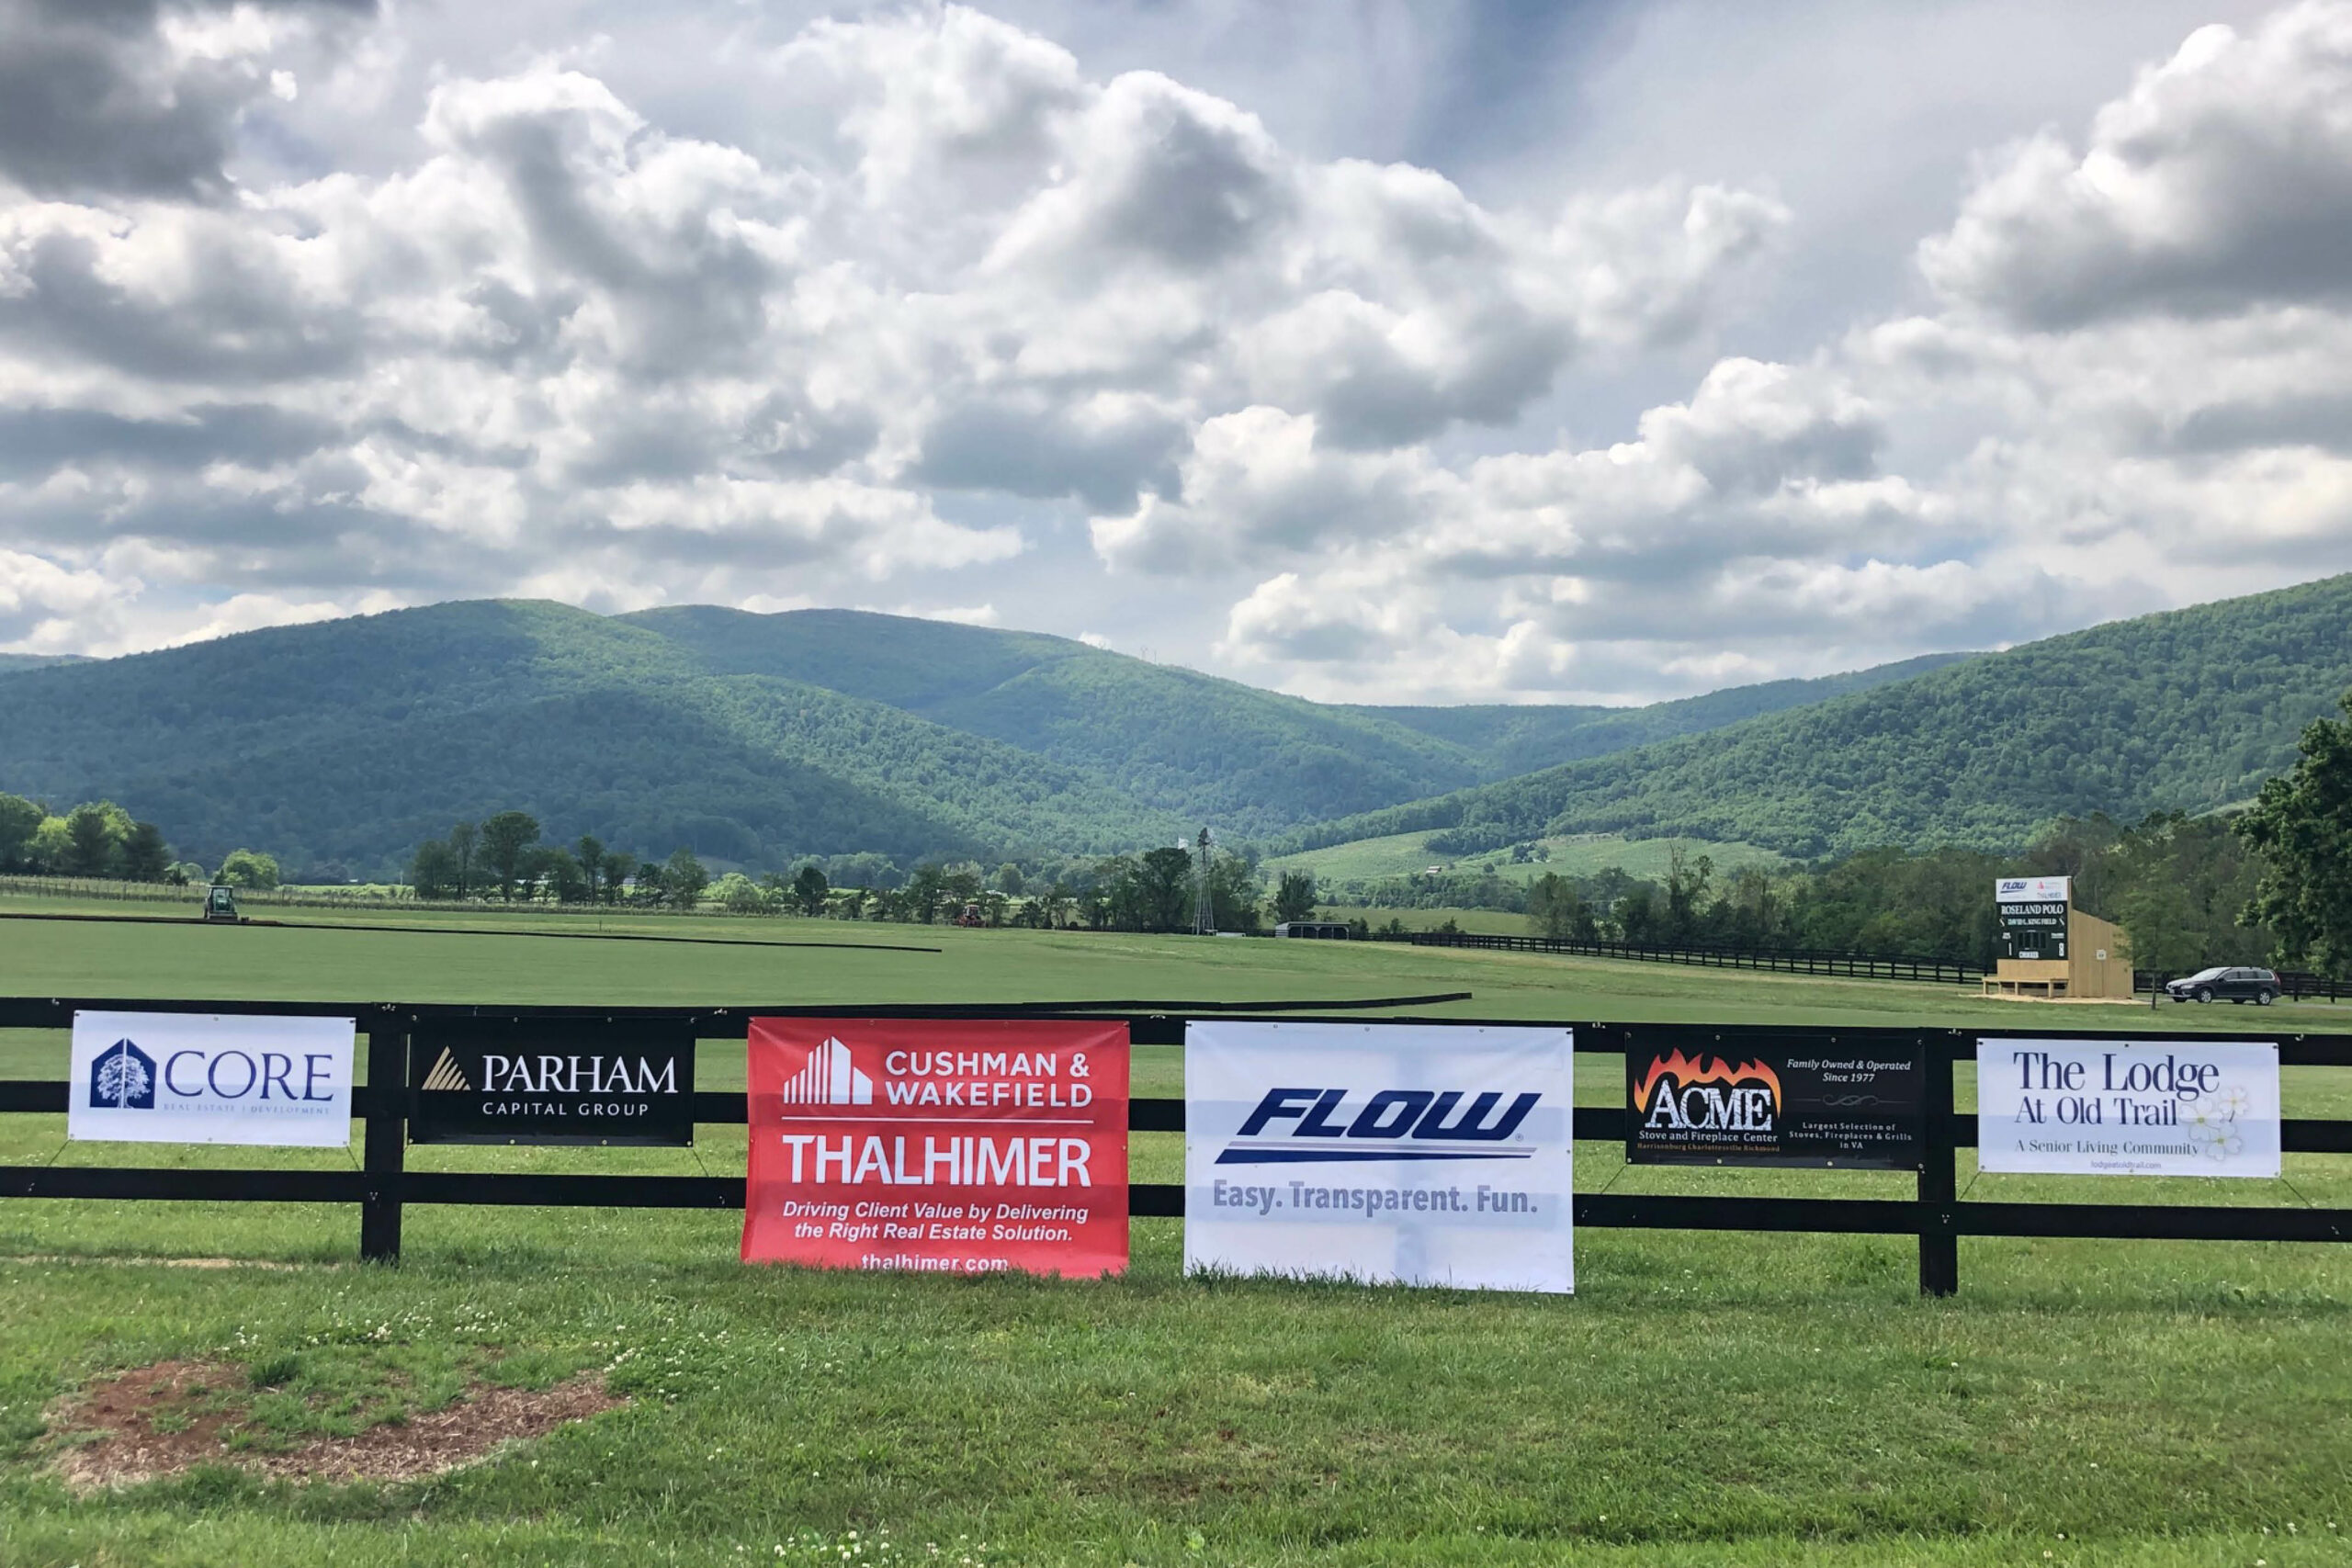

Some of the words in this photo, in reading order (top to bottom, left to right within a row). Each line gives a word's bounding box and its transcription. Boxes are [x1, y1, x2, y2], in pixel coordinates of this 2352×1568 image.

[2001, 905, 2041, 915] ROSELAND
[2042, 904, 2064, 914] POLO
[481, 1055, 678, 1093] PARHAM
[886, 1051, 1057, 1077] CUSHMAN
[1069, 1053, 1090, 1077] &
[1787, 1059, 1819, 1070] Family
[1822, 1060, 1854, 1069] Owned
[1856, 1060, 1864, 1069] &
[1867, 1061, 1911, 1071] Operated
[164, 1050, 334, 1101] CORE
[1823, 1072, 1848, 1082] Since
[1850, 1073, 1875, 1082] 1977
[2014, 1052, 2086, 1091] The
[2102, 1054, 2220, 1101] Lodge
[886, 1081, 1092, 1108] WAKEFIELD
[1645, 1079, 1771, 1131] ACME
[197, 1104, 235, 1112] ESTATE
[251, 1105, 330, 1114] DEVELOPMENT
[482, 1102, 567, 1115] CAPITAL
[579, 1103, 649, 1116] GROUP
[1237, 1088, 1543, 1141] FLOW
[2015, 1096, 2047, 1124] At
[2056, 1096, 2102, 1124] Old
[2113, 1098, 2178, 1126] Trail
[1639, 1131, 1667, 1140] Stove
[1669, 1131, 1688, 1140] and
[1691, 1132, 1738, 1143] Fireplace
[1744, 1133, 1778, 1142] Center
[1789, 1131, 1823, 1139] Stoves,
[1825, 1132, 1872, 1140] Fireplaces
[1803, 1122, 1837, 1131] Largest
[1839, 1122, 1883, 1131] Selection
[2016, 1140, 2025, 1152] A
[2030, 1139, 2072, 1153] Senior
[2076, 1141, 2118, 1155] Living
[2123, 1141, 2199, 1157] Community
[783, 1134, 1091, 1188] THALHIMER
[1214, 1179, 1283, 1215] Easy.
[1289, 1181, 1468, 1217] Transparent.
[1477, 1185, 1537, 1213] Fun.
[783, 1201, 850, 1219] Driving
[854, 1201, 908, 1218] Client
[914, 1203, 963, 1219] Value
[968, 1204, 990, 1223] by
[996, 1204, 1089, 1224] Delivering
[795, 1223, 823, 1237] the
[829, 1223, 878, 1242] Right
[883, 1224, 923, 1239] Real
[929, 1224, 987, 1240] Estate
[992, 1224, 1072, 1241] Solution.
[862, 1254, 1008, 1271] thalhimer.com
